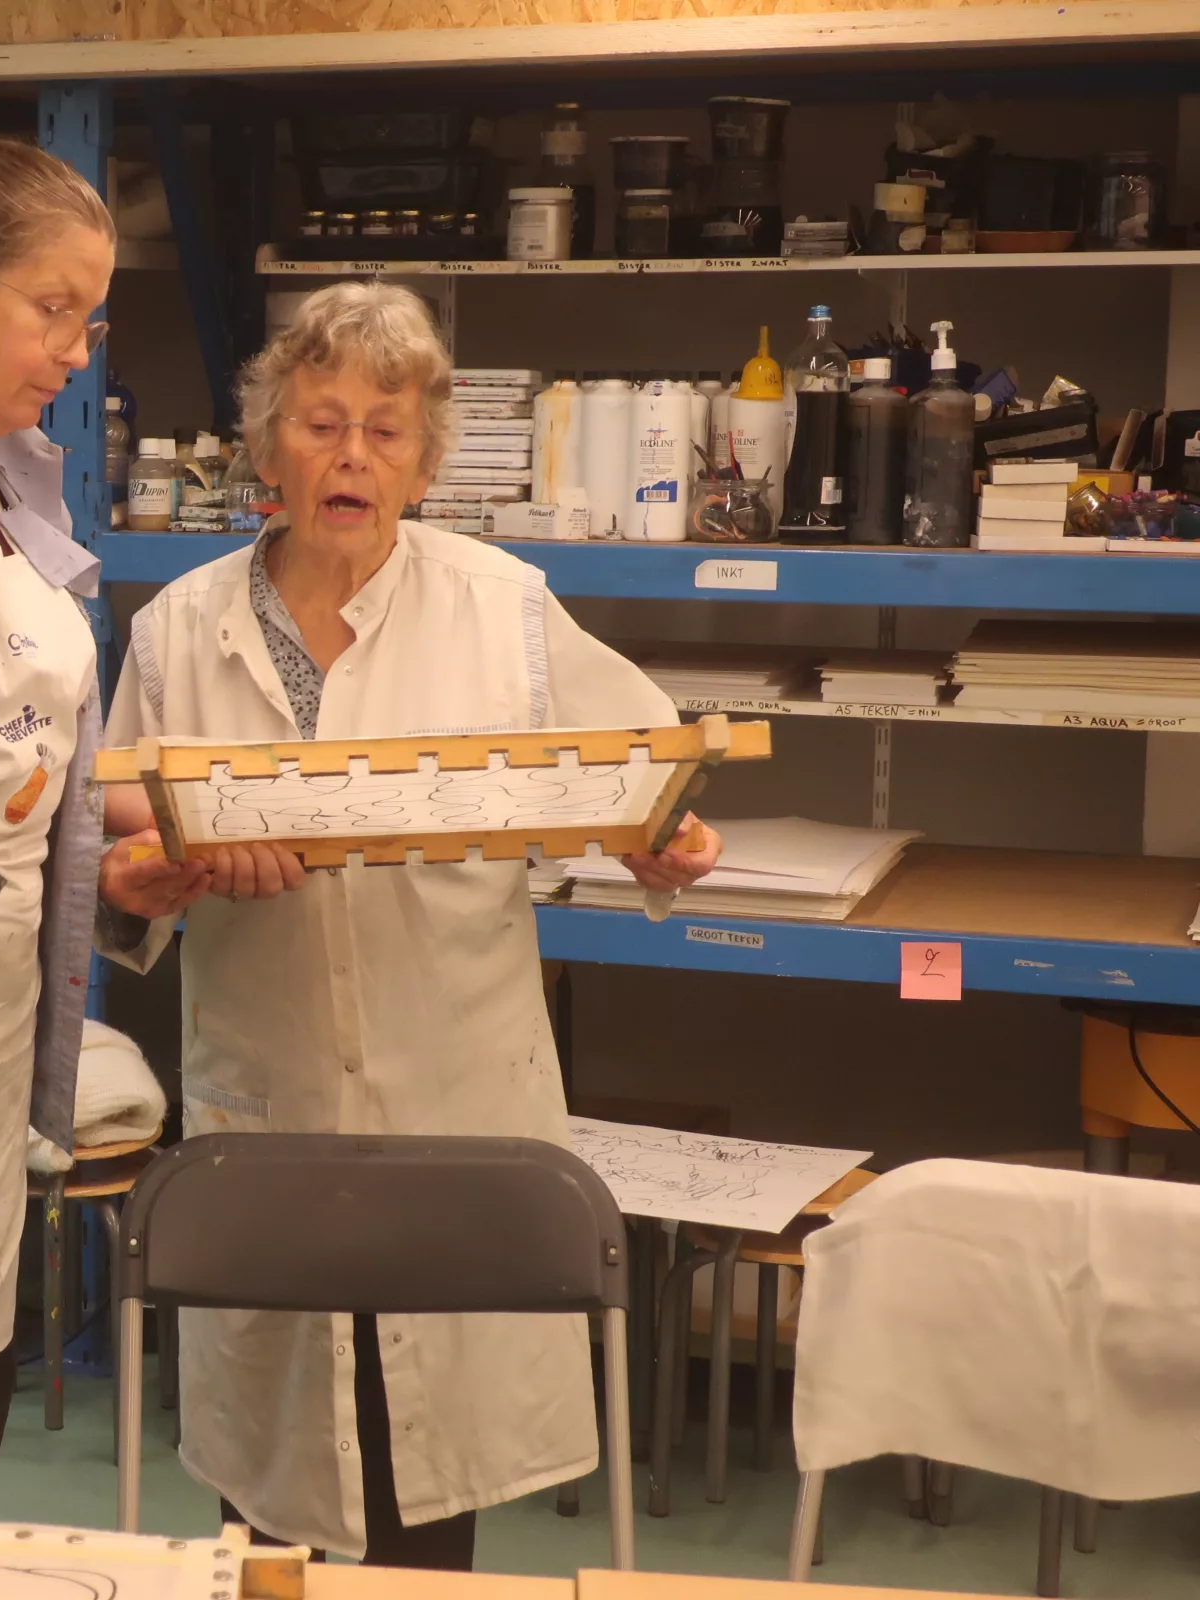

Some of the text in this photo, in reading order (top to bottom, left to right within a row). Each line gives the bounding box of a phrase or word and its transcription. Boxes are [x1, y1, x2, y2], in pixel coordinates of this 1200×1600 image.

[440, 263, 475, 271] BISTER
[618, 262, 651, 270] BISTER
[751, 259, 789, 267] ZWART
[639, 439, 675, 448] ECOLINE
[732, 437, 757, 446] OLINE
[716, 566, 745, 579] INKT
[686, 699, 720, 711] TEKEN
[834, 704, 854, 716] A5
[859, 704, 900, 717] TEKEN
[1063, 715, 1083, 725] A3
[1089, 717, 1129, 728] AQUA
[1147, 717, 1186, 727] GROOT
[5, 716, 53, 743] CREVETTE
[691, 928, 761, 945] GROOT TEKEN
